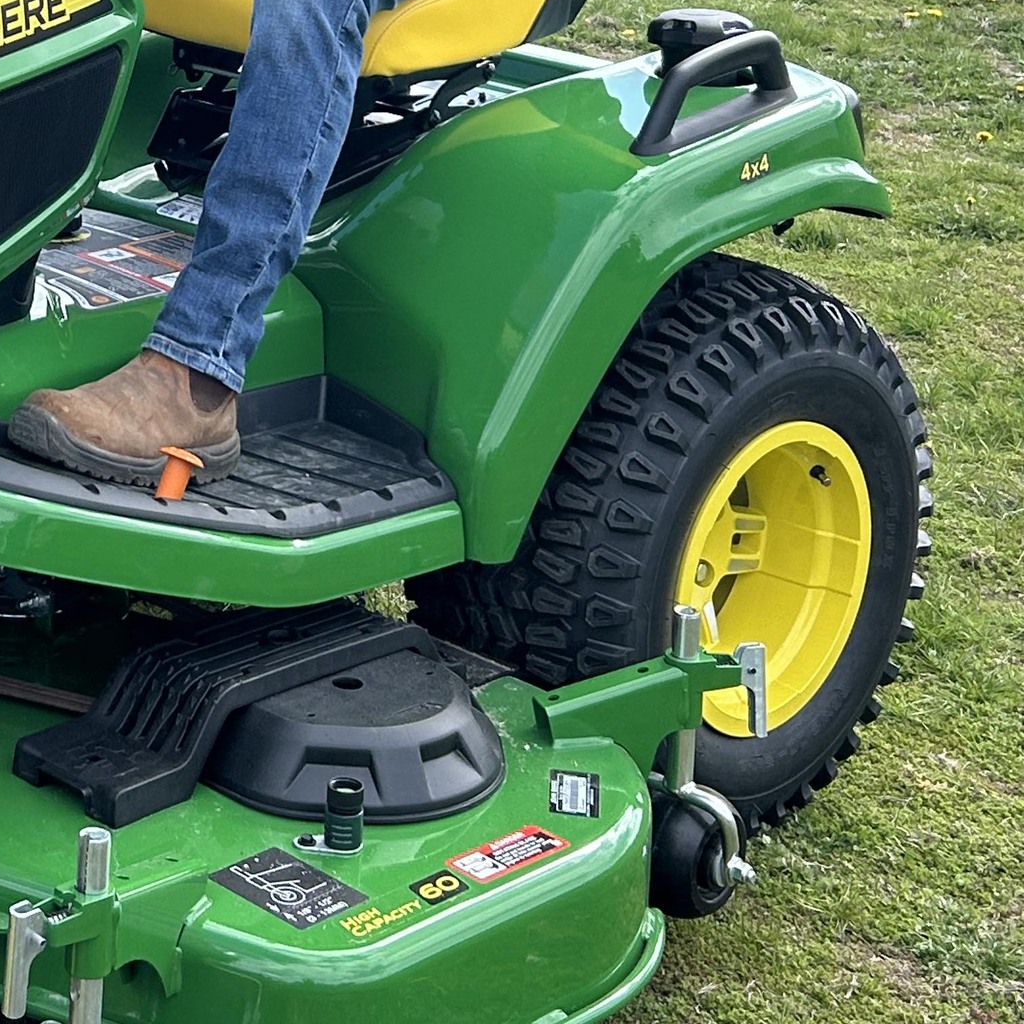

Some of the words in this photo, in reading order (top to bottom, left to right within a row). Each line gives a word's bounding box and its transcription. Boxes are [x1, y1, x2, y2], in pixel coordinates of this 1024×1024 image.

[740, 152, 770, 181] 4x4
[419, 875, 460, 900] 60
[339, 907, 381, 931] HIGH
[351, 899, 422, 937] CAPACITY
